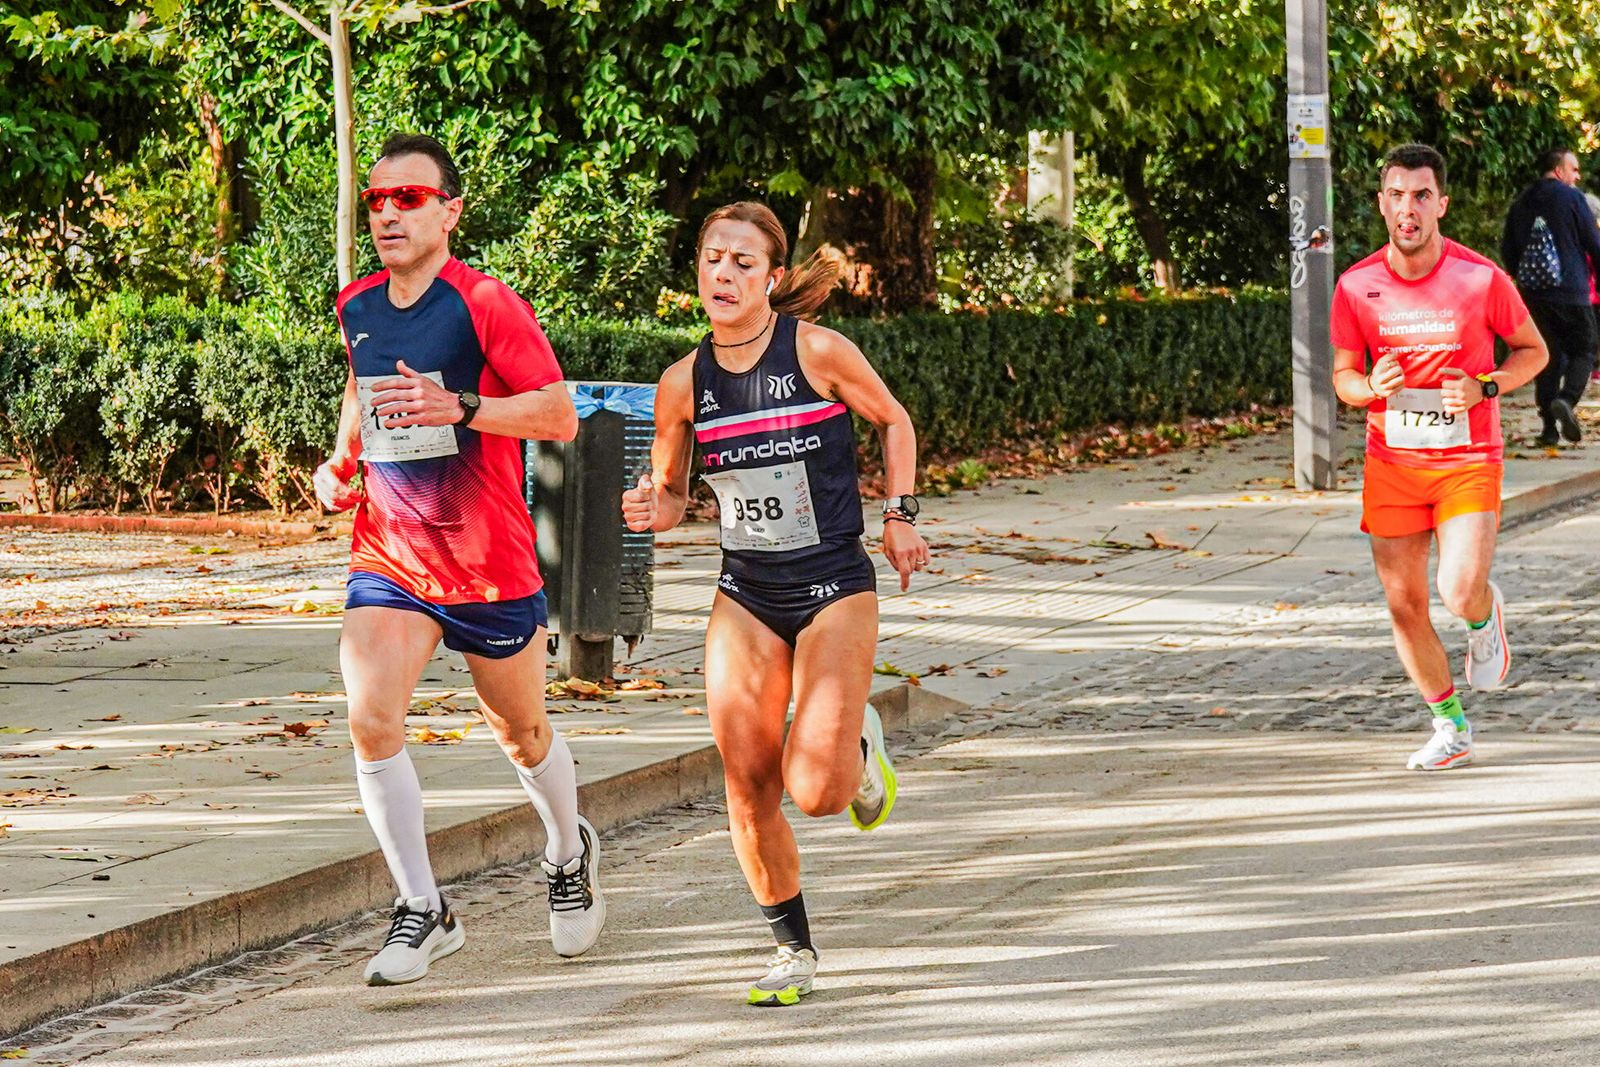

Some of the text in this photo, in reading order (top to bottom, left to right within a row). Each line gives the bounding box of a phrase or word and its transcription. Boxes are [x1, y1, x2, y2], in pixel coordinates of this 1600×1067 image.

[1439, 308, 1454, 319] de
[1379, 320, 1455, 336] humanidad
[1399, 409, 1456, 427] 1729
[733, 496, 784, 521] 958
